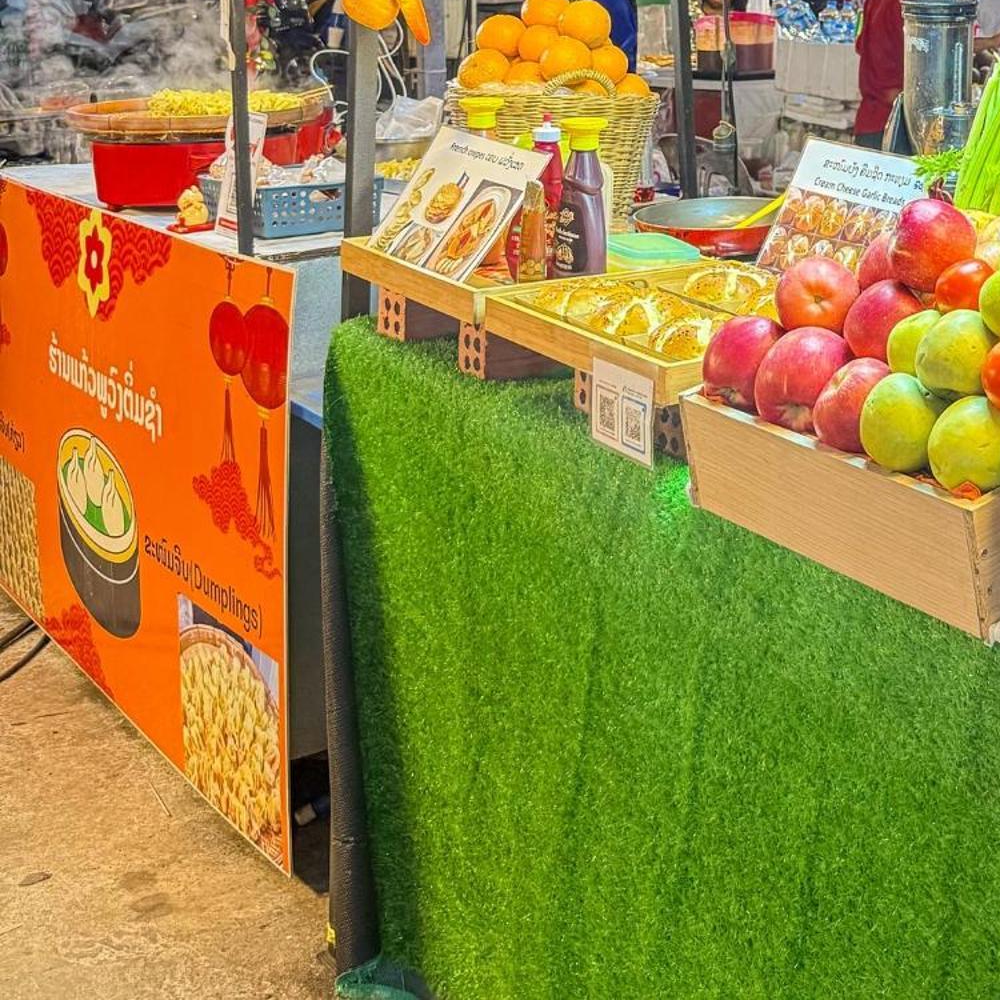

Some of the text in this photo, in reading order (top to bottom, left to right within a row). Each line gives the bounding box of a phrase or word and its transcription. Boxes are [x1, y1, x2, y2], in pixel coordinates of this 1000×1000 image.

[814, 176, 836, 190] Cream
[836, 181, 861, 197] Cheese
[861, 187, 881, 202] Garlic
